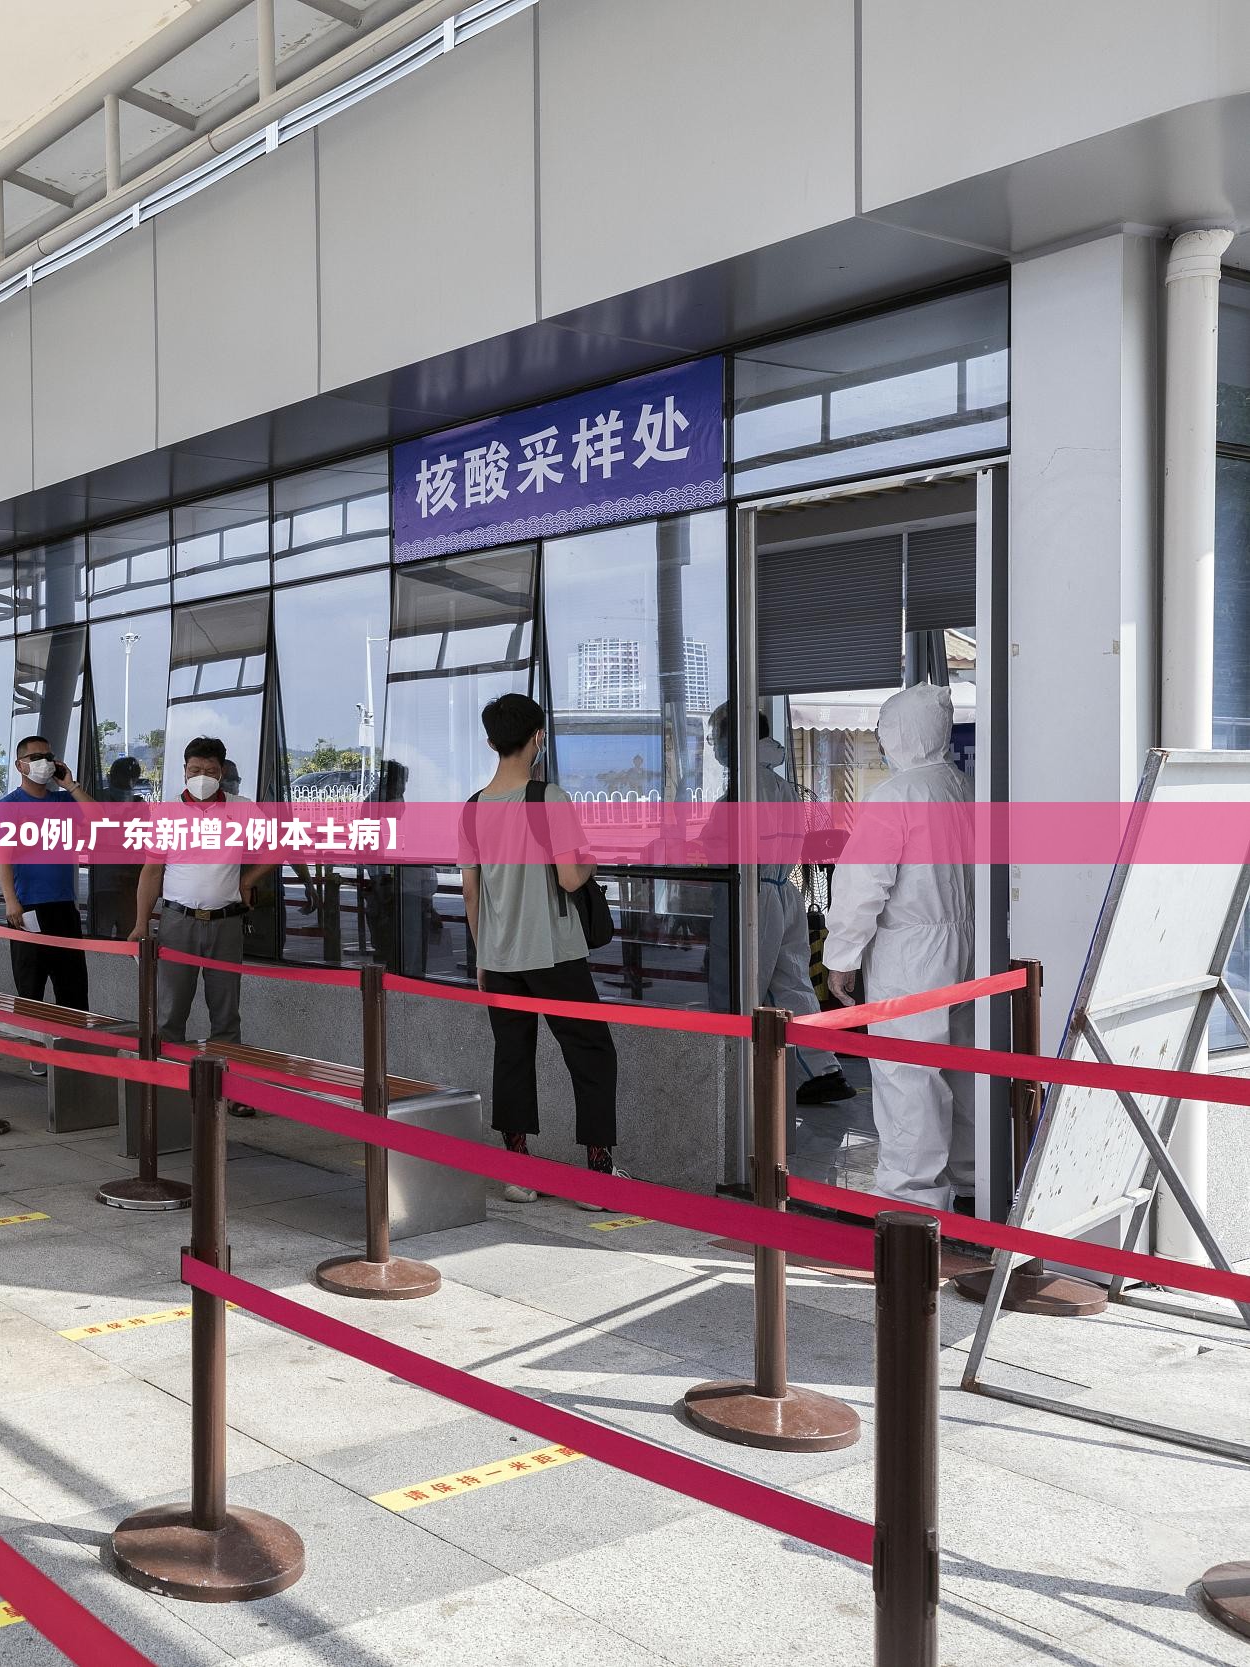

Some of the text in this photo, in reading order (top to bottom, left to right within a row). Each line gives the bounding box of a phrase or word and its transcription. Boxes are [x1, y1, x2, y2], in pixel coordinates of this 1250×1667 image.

[414, 396, 690, 518] 核酸采样处
